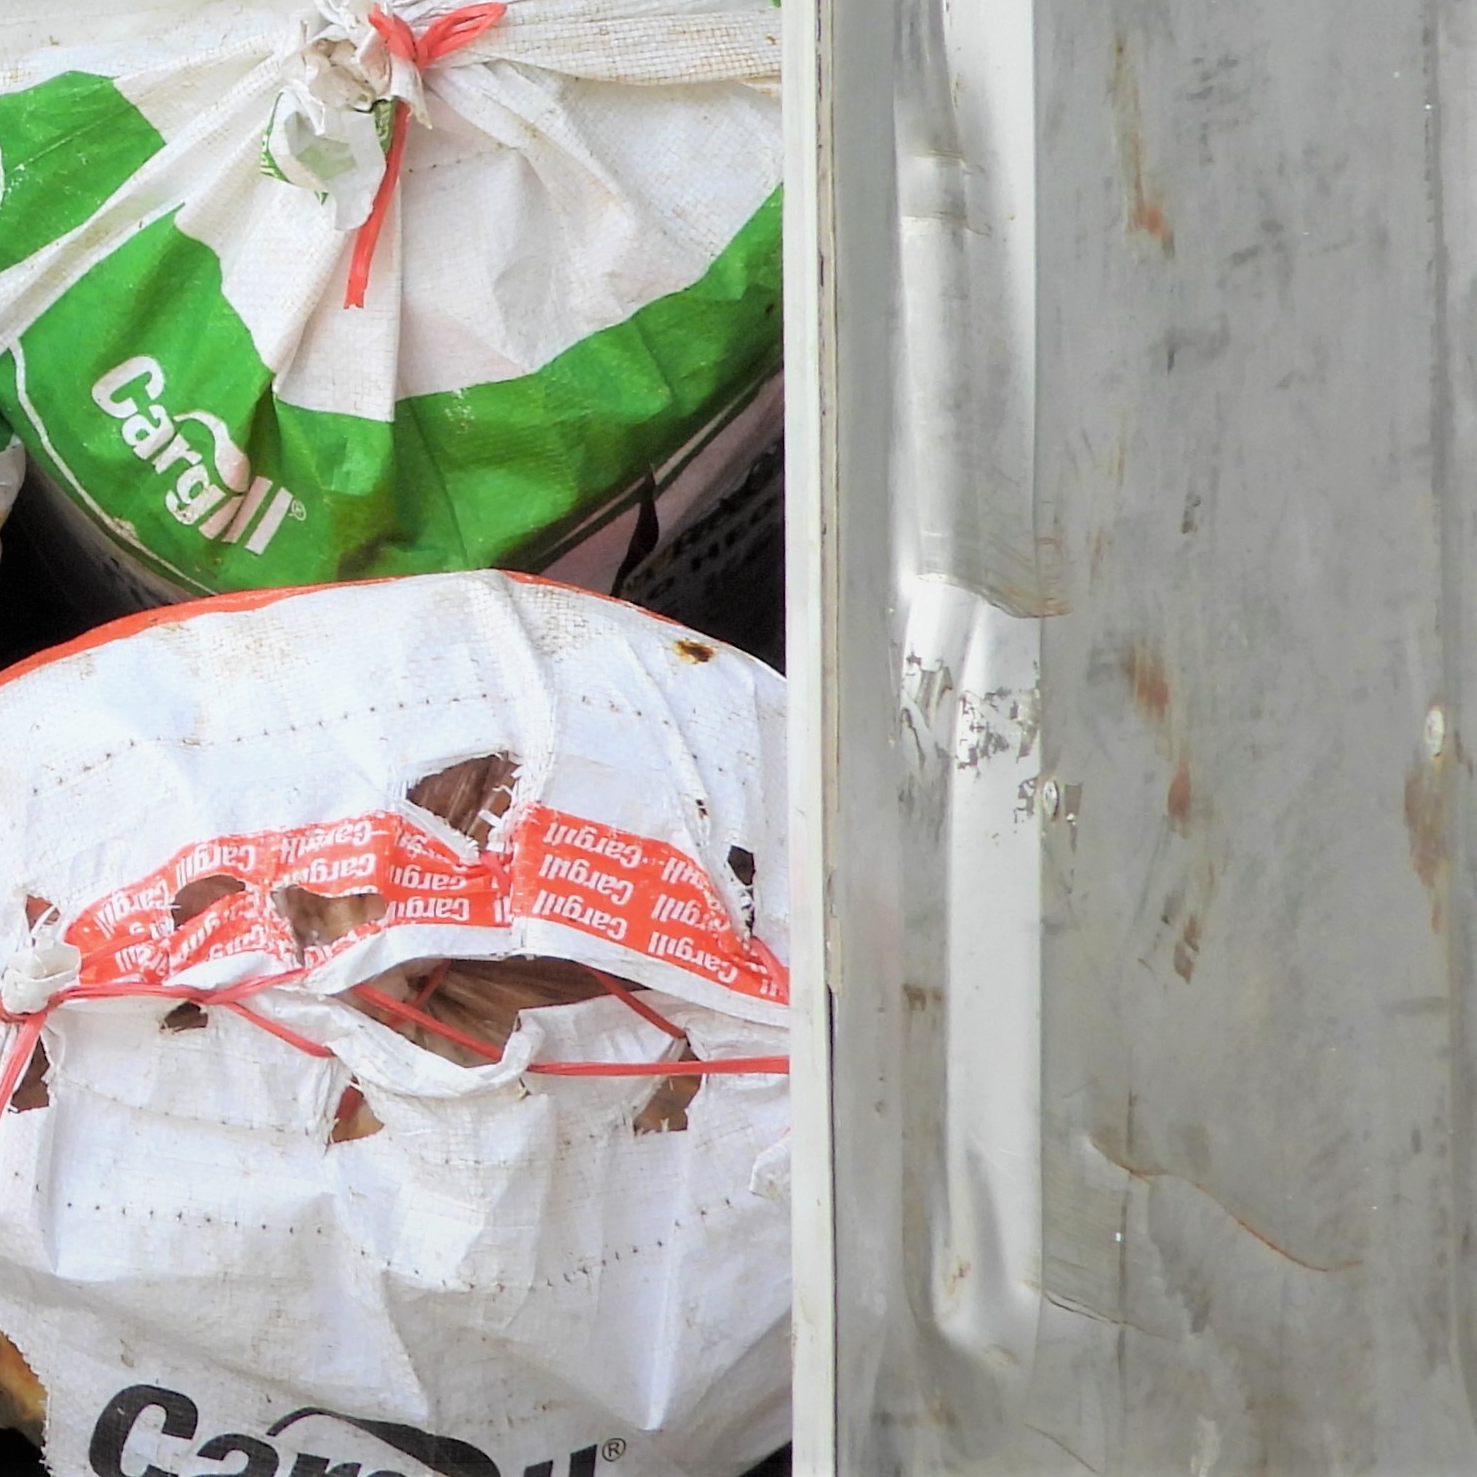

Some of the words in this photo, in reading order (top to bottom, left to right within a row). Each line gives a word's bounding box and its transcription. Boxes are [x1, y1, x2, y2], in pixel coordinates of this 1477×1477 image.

[91, 354, 295, 556] Cargill
[176, 844, 256, 888] Cargill
[543, 821, 643, 869] Cargill
[538, 854, 635, 906] Cargill
[93, 878, 170, 940] Cargill
[532, 889, 629, 942] Cargill
[648, 930, 740, 985] Cargill
[89, 1383, 598, 1477] Carll
